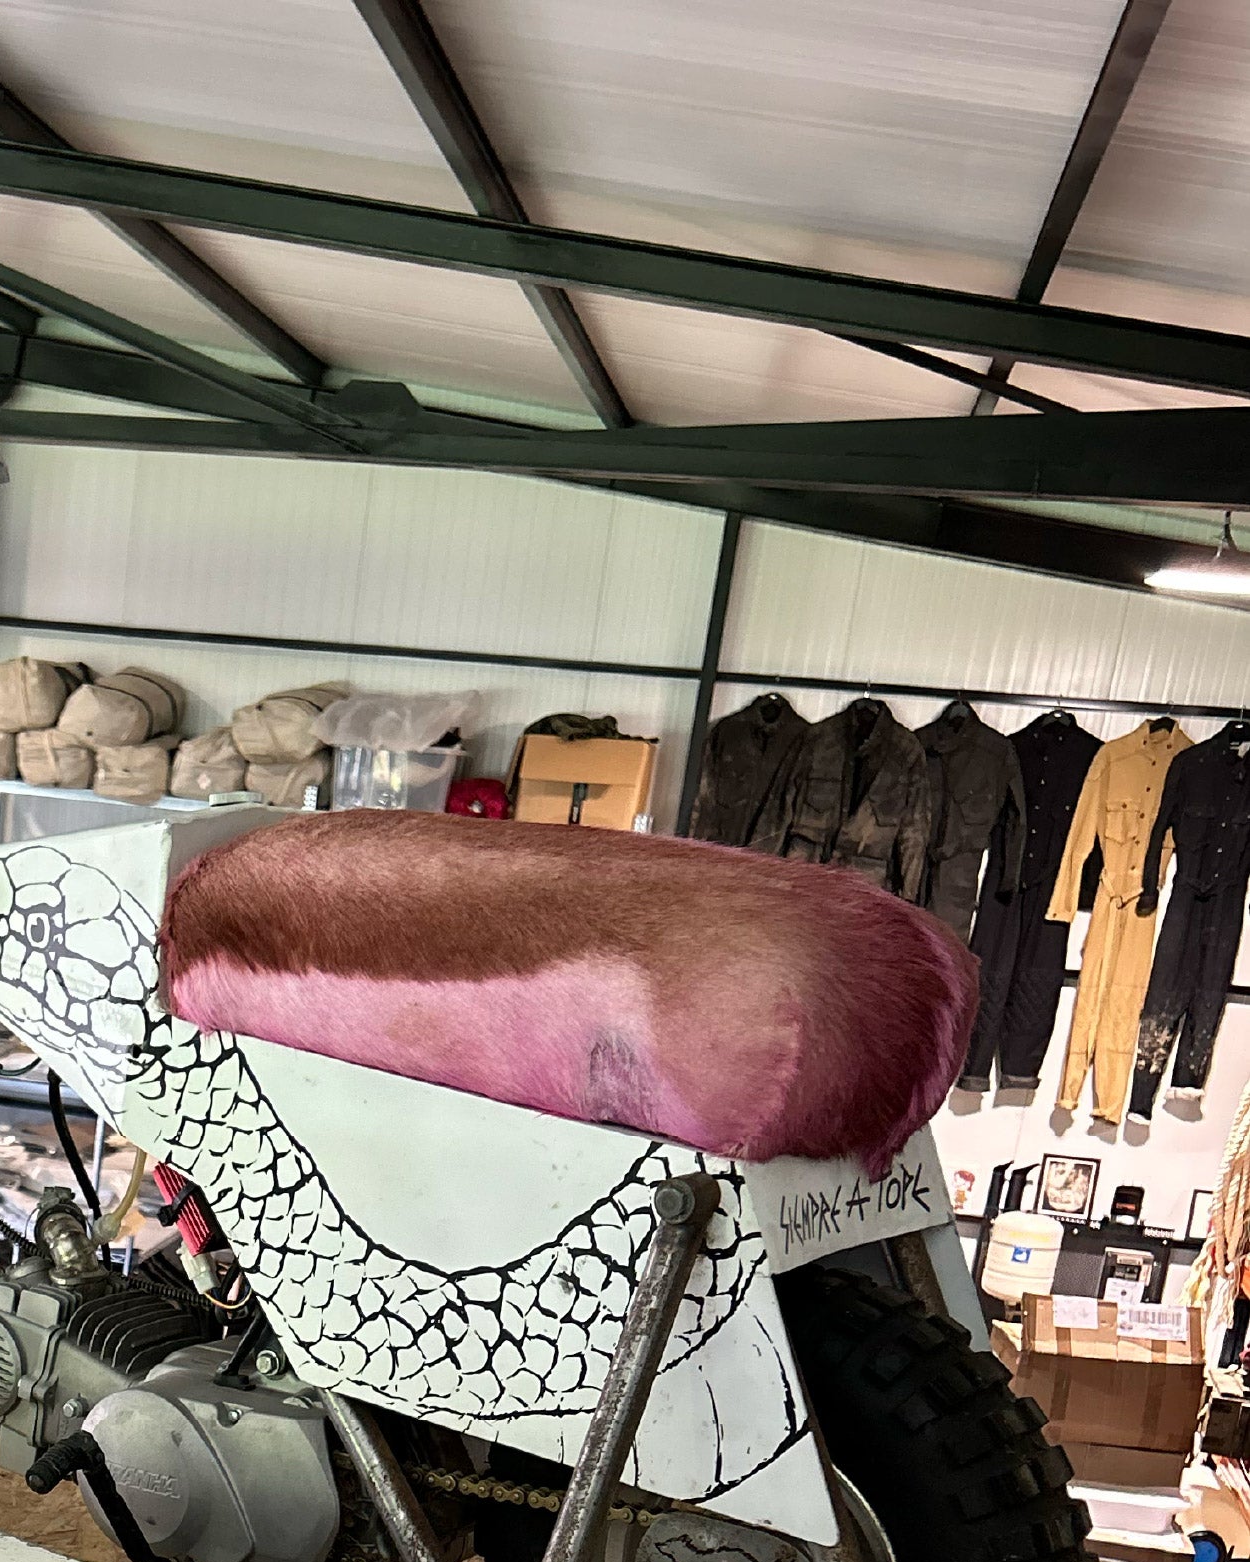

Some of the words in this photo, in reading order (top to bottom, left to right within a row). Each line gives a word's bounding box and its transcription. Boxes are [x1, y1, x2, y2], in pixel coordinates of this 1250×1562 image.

[780, 1184, 842, 1255] SIEMPRE
[846, 1176, 871, 1222] A
[877, 1162, 931, 1213] TOPE
[106, 1460, 181, 1499] RANHA
